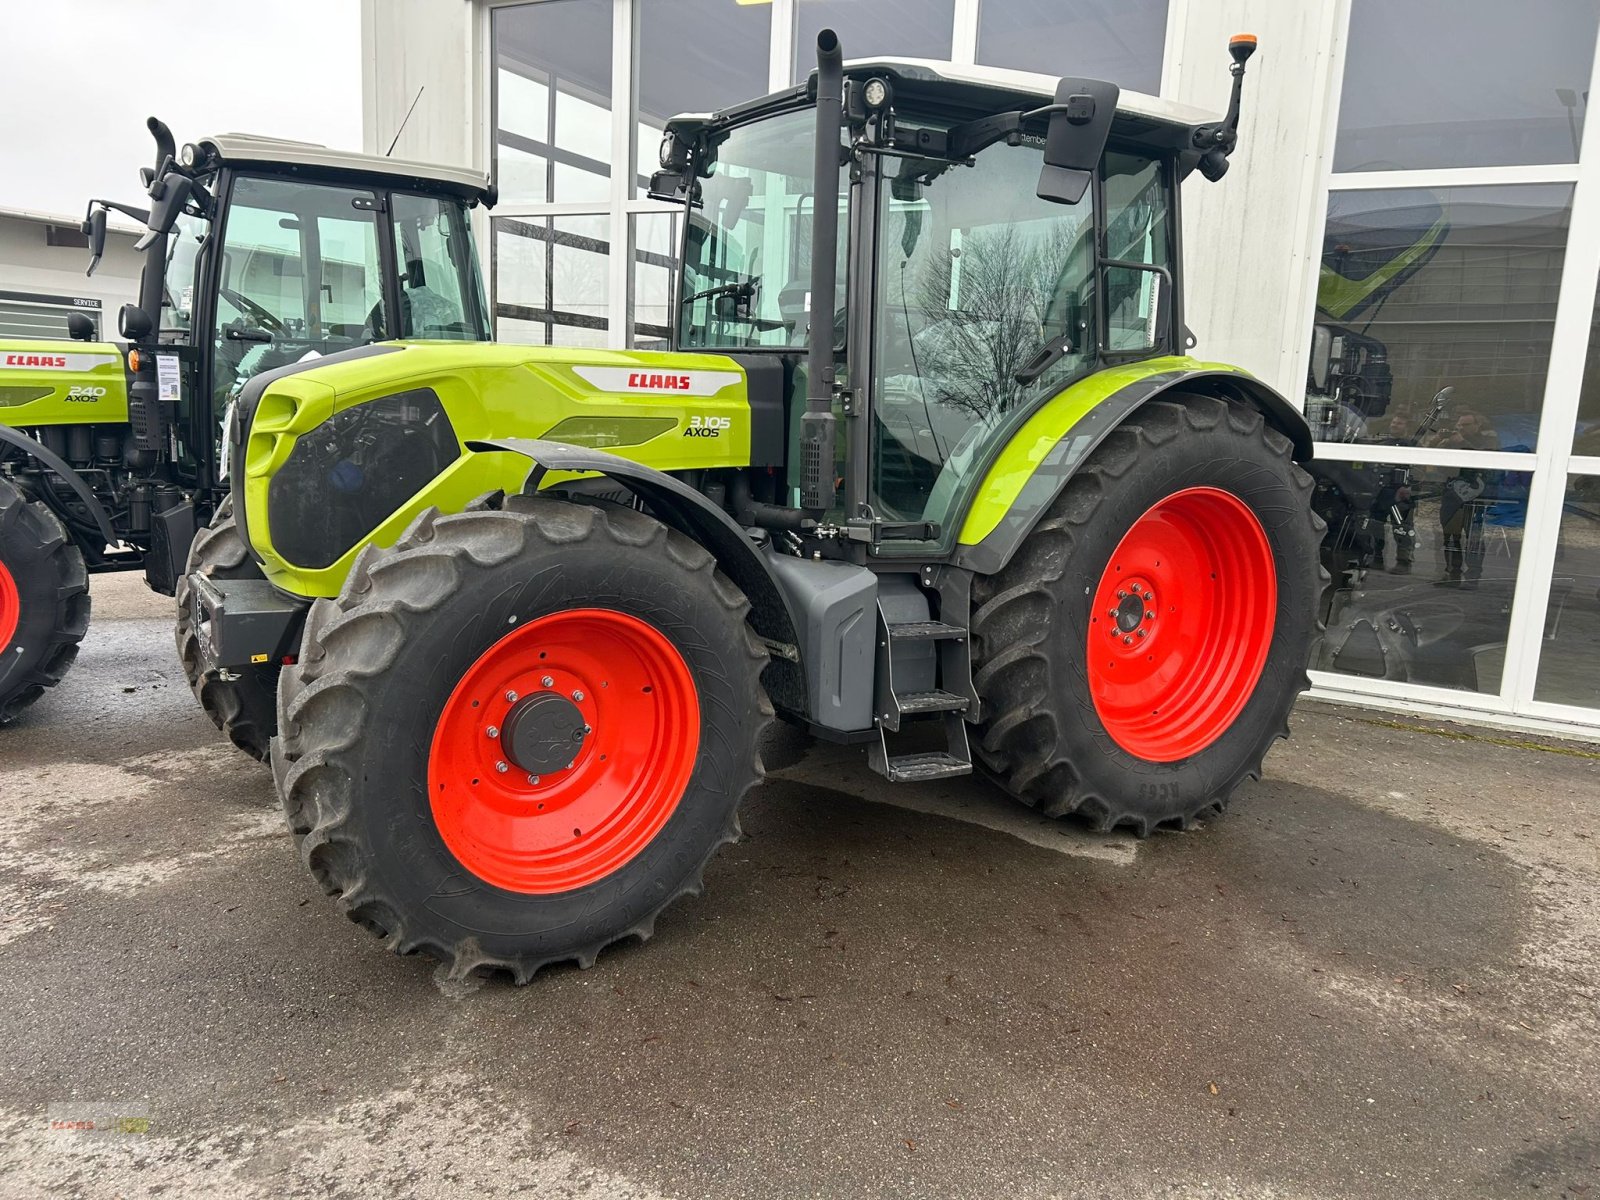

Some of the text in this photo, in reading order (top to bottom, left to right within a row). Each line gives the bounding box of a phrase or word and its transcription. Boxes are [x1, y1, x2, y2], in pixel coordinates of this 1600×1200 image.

[73, 298, 99, 308] SERVICE
[6, 355, 66, 367] CLAAS
[628, 373, 690, 390] CLAAS
[68, 386, 107, 397] 240
[64, 395, 99, 403] AXOS
[690, 416, 731, 428] 3.105
[683, 427, 719, 438] AXOS
